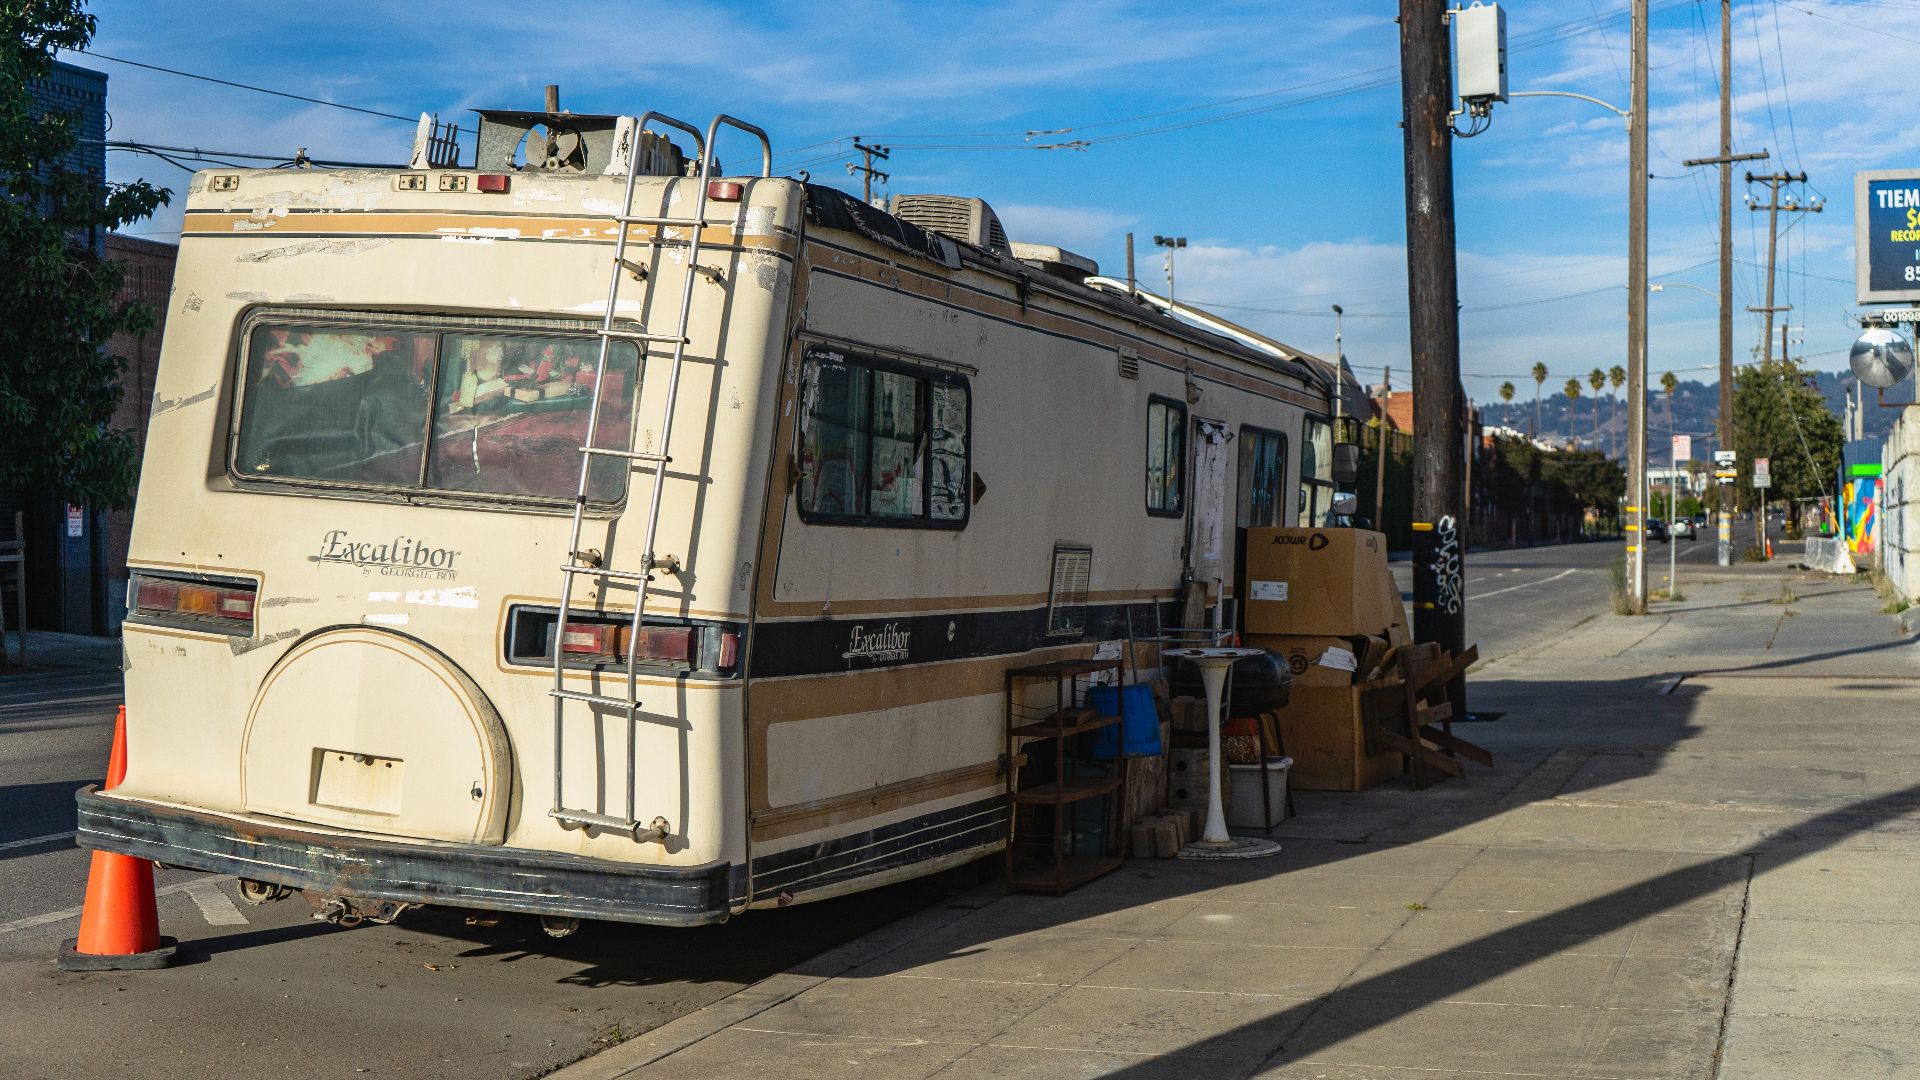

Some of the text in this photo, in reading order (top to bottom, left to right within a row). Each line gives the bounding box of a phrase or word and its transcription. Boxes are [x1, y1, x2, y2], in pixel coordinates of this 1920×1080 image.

[1877, 189, 1920, 208] TIEM
[318, 529, 462, 568] Excalibor
[1271, 535, 1307, 545] amcor
[380, 566, 432, 580] GEORGIE
[849, 622, 911, 654] Excalibor
